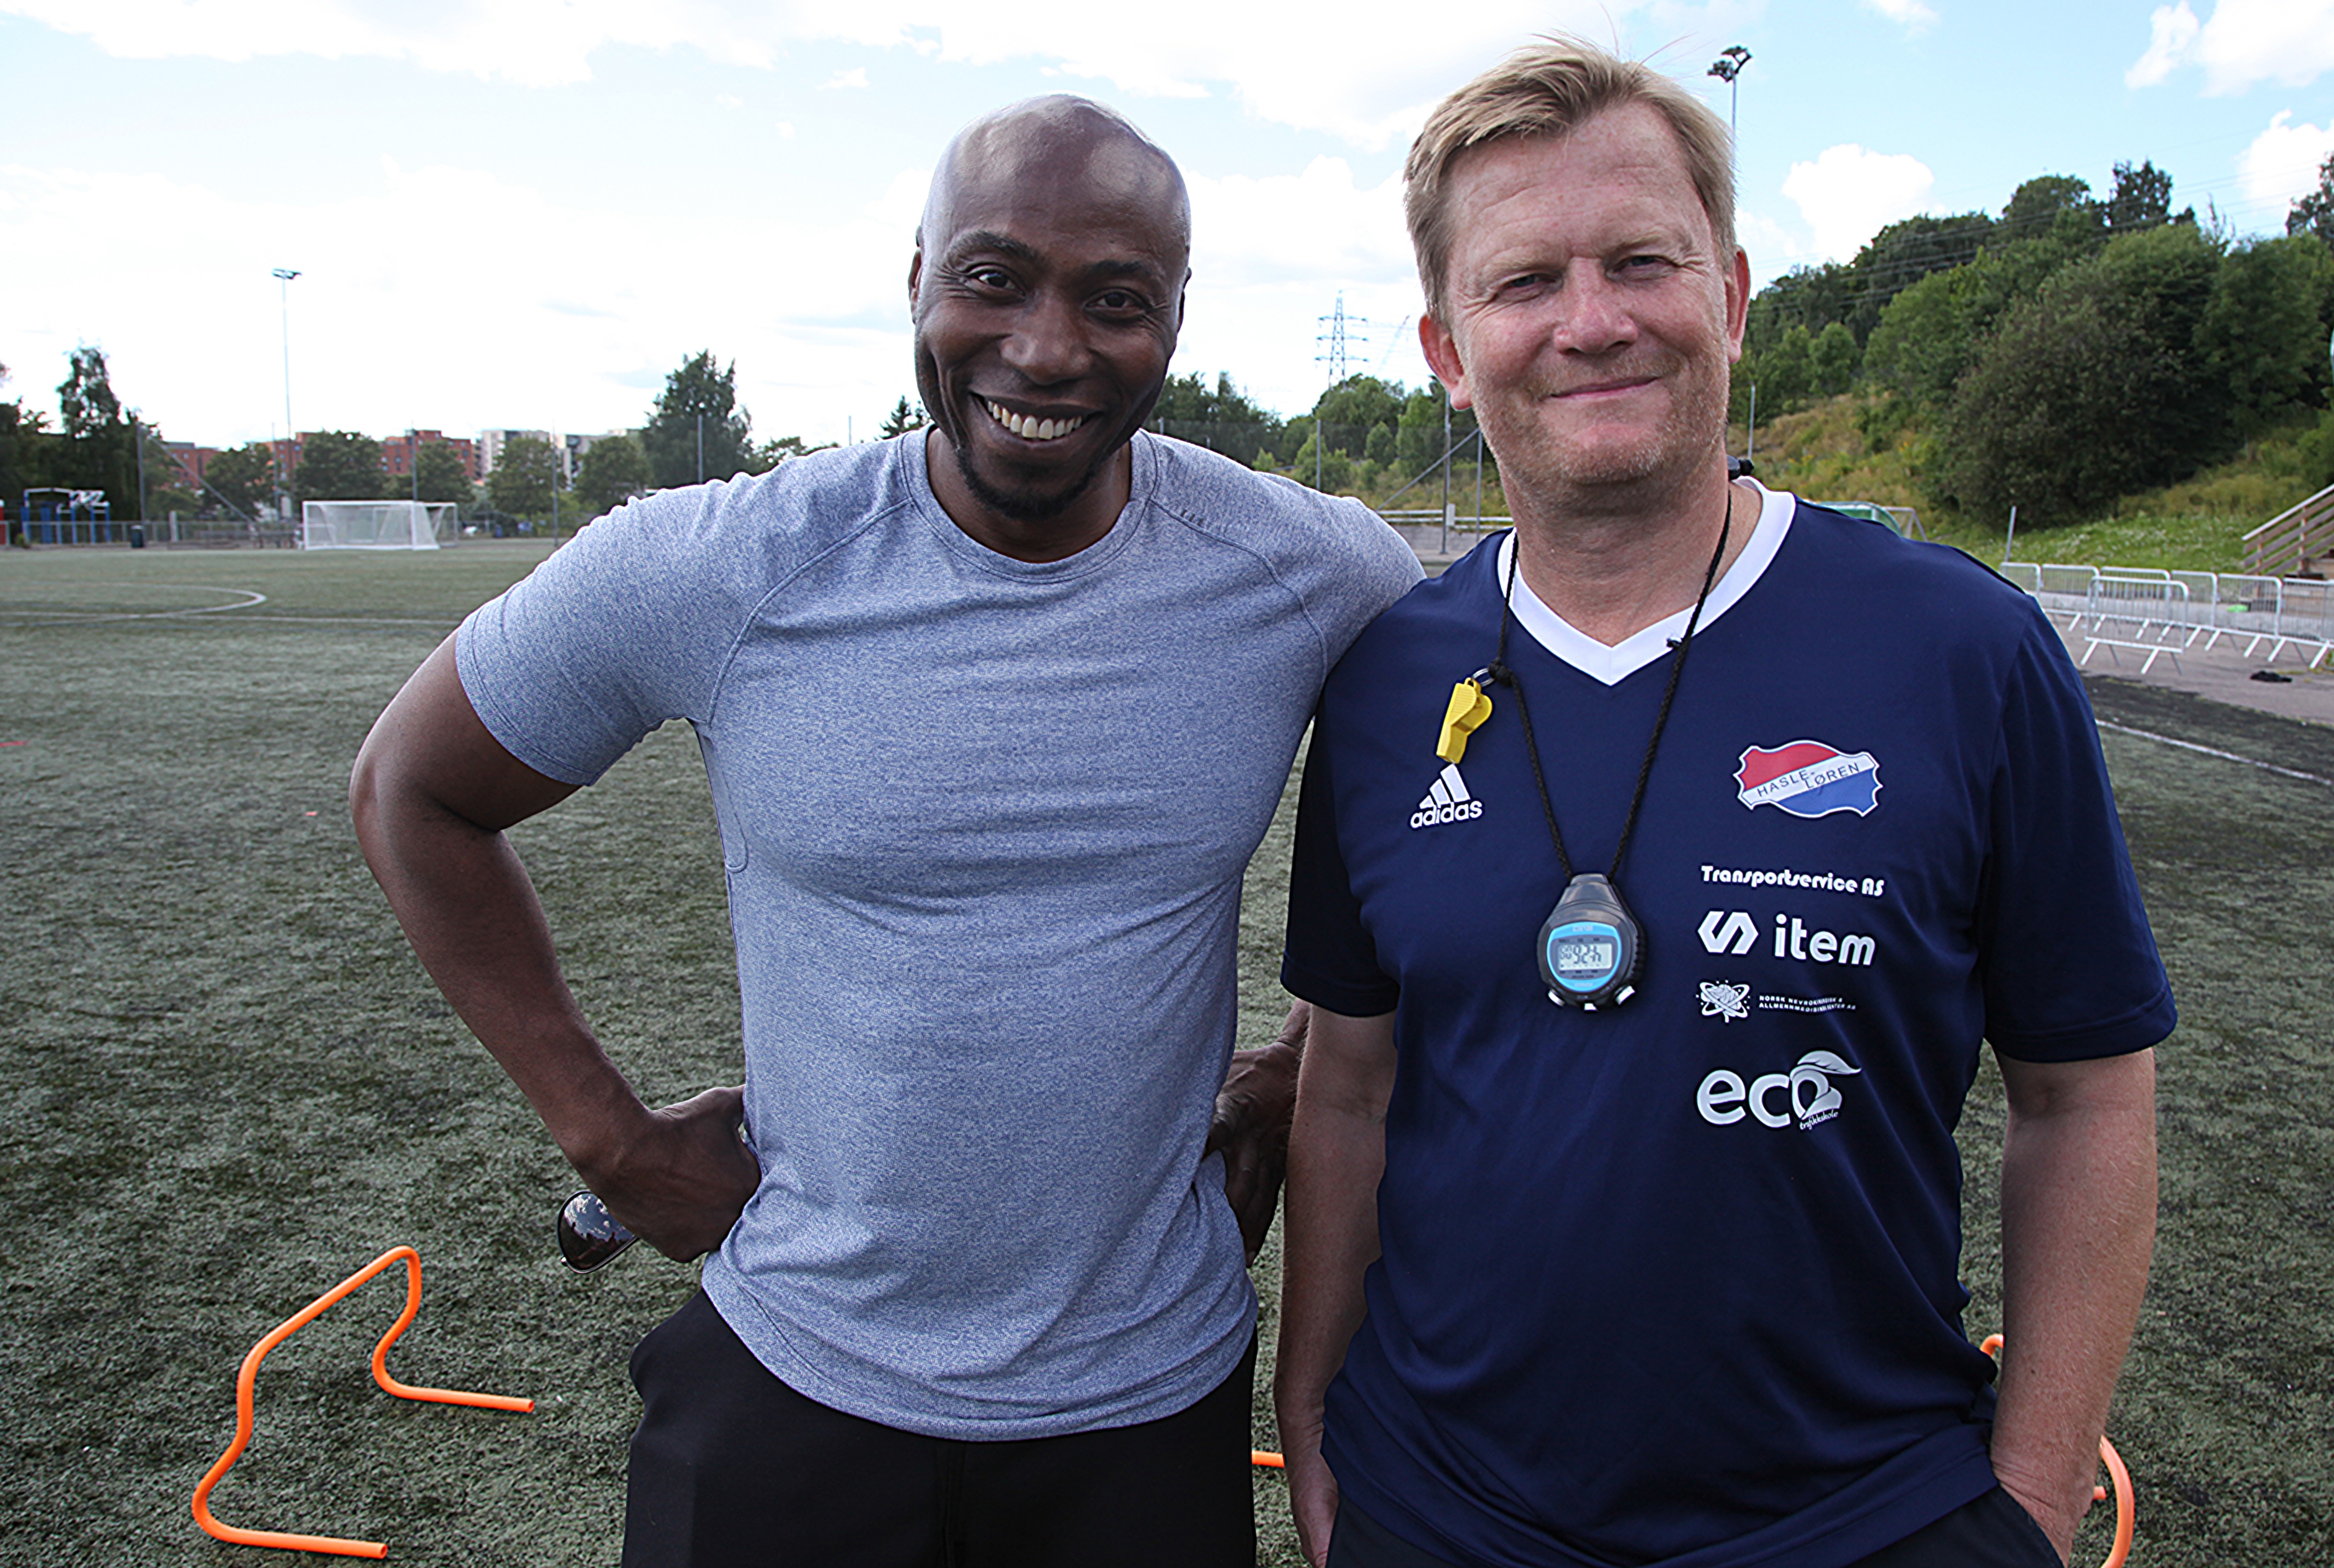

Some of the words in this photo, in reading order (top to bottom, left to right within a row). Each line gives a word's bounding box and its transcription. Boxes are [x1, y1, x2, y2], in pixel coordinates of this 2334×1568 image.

[1757, 770, 1815, 797] HASLE-
[1804, 762, 1860, 790] LØREN
[1410, 800, 1483, 829] adidas
[1701, 866, 1858, 893] Transportservice
[1862, 878, 1884, 896] AS
[1775, 914, 1875, 965] item
[1697, 1065, 1843, 1128] eco
